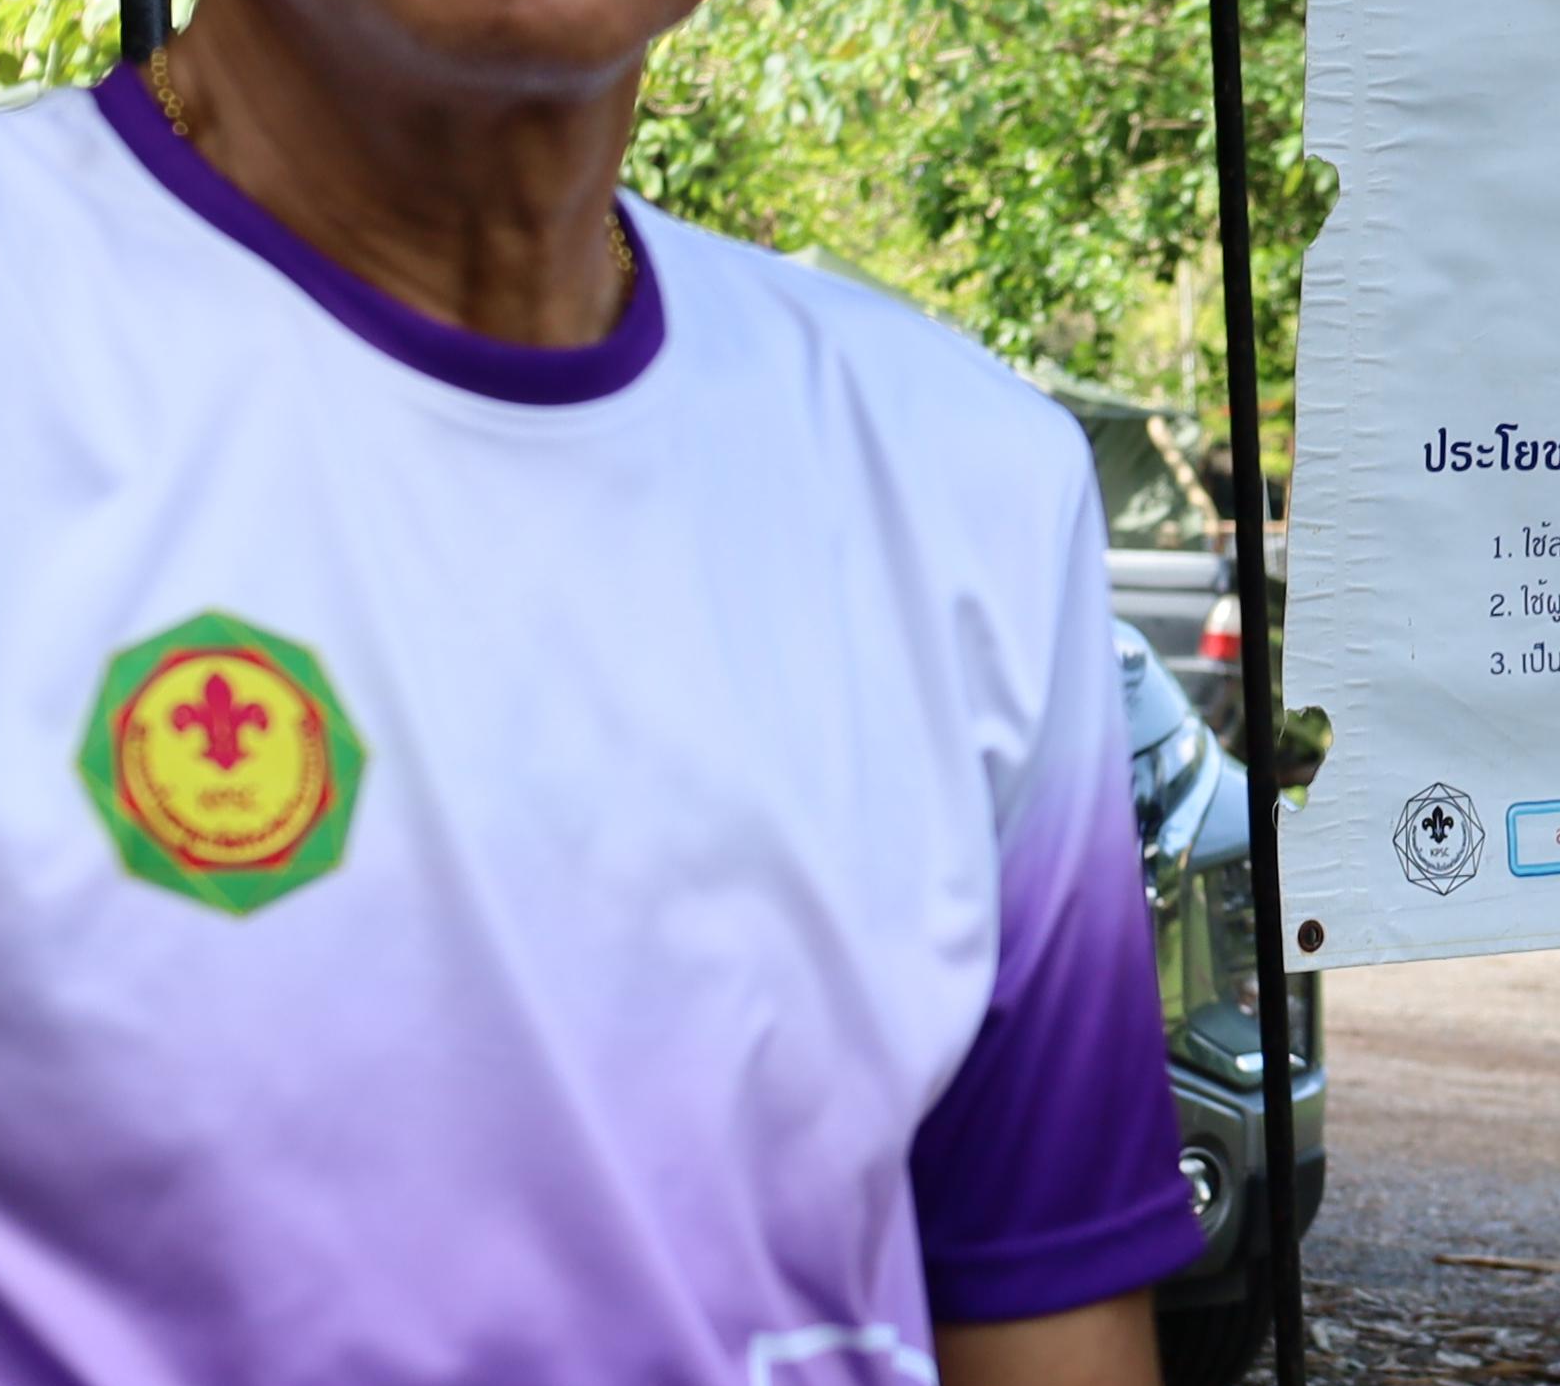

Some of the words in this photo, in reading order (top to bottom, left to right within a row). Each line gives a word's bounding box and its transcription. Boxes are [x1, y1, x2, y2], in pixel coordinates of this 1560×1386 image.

[1492, 535, 1513, 559] 1.
[1490, 594, 1512, 617] 2.
[1490, 651, 1512, 675] 3.
